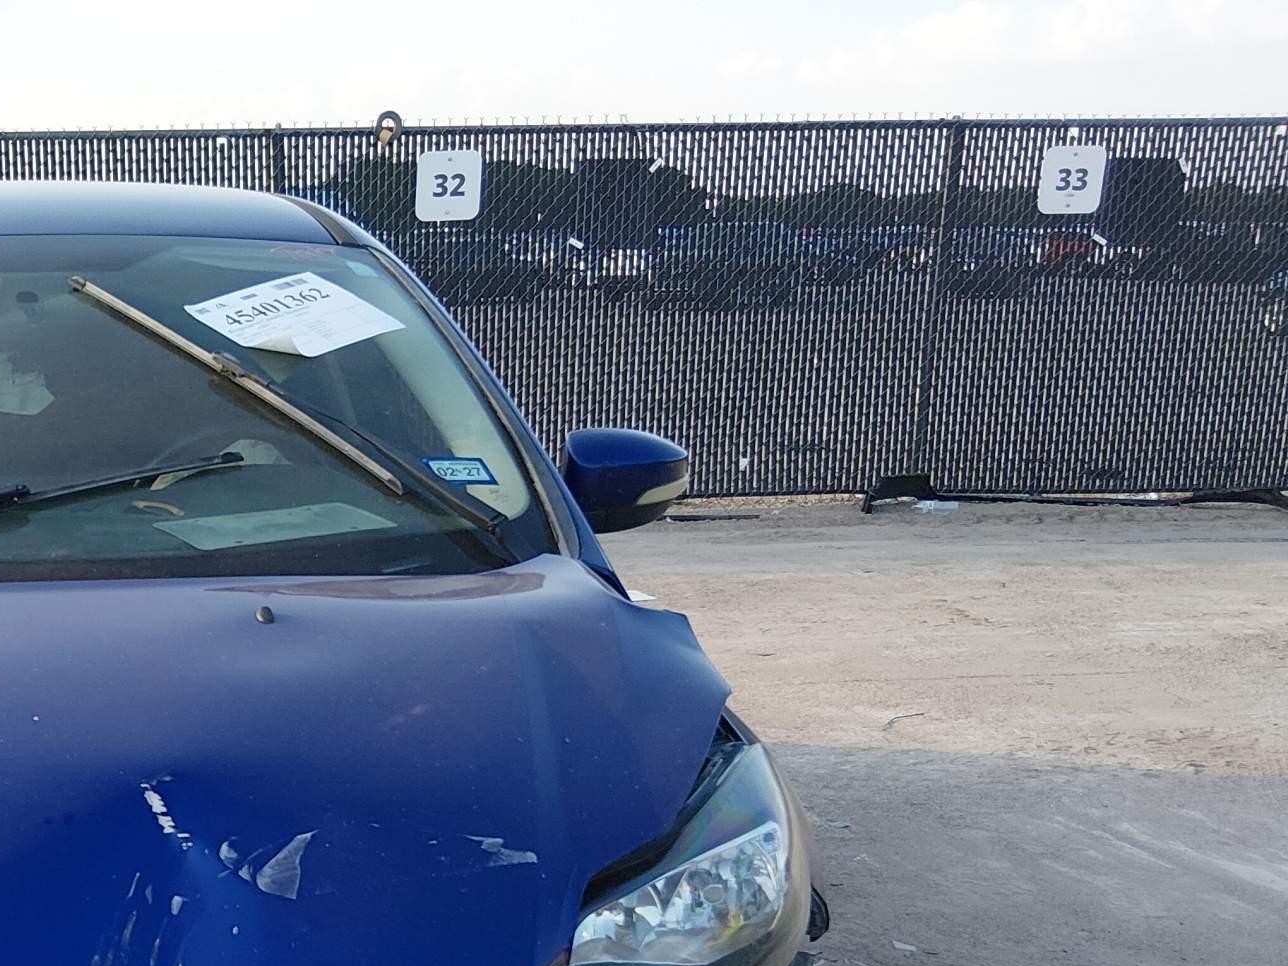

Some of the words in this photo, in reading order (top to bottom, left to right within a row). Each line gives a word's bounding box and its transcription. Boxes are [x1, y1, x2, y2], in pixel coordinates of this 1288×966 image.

[432, 173, 466, 197] 32
[1055, 168, 1089, 191] 33
[225, 288, 330, 325] 45401362
